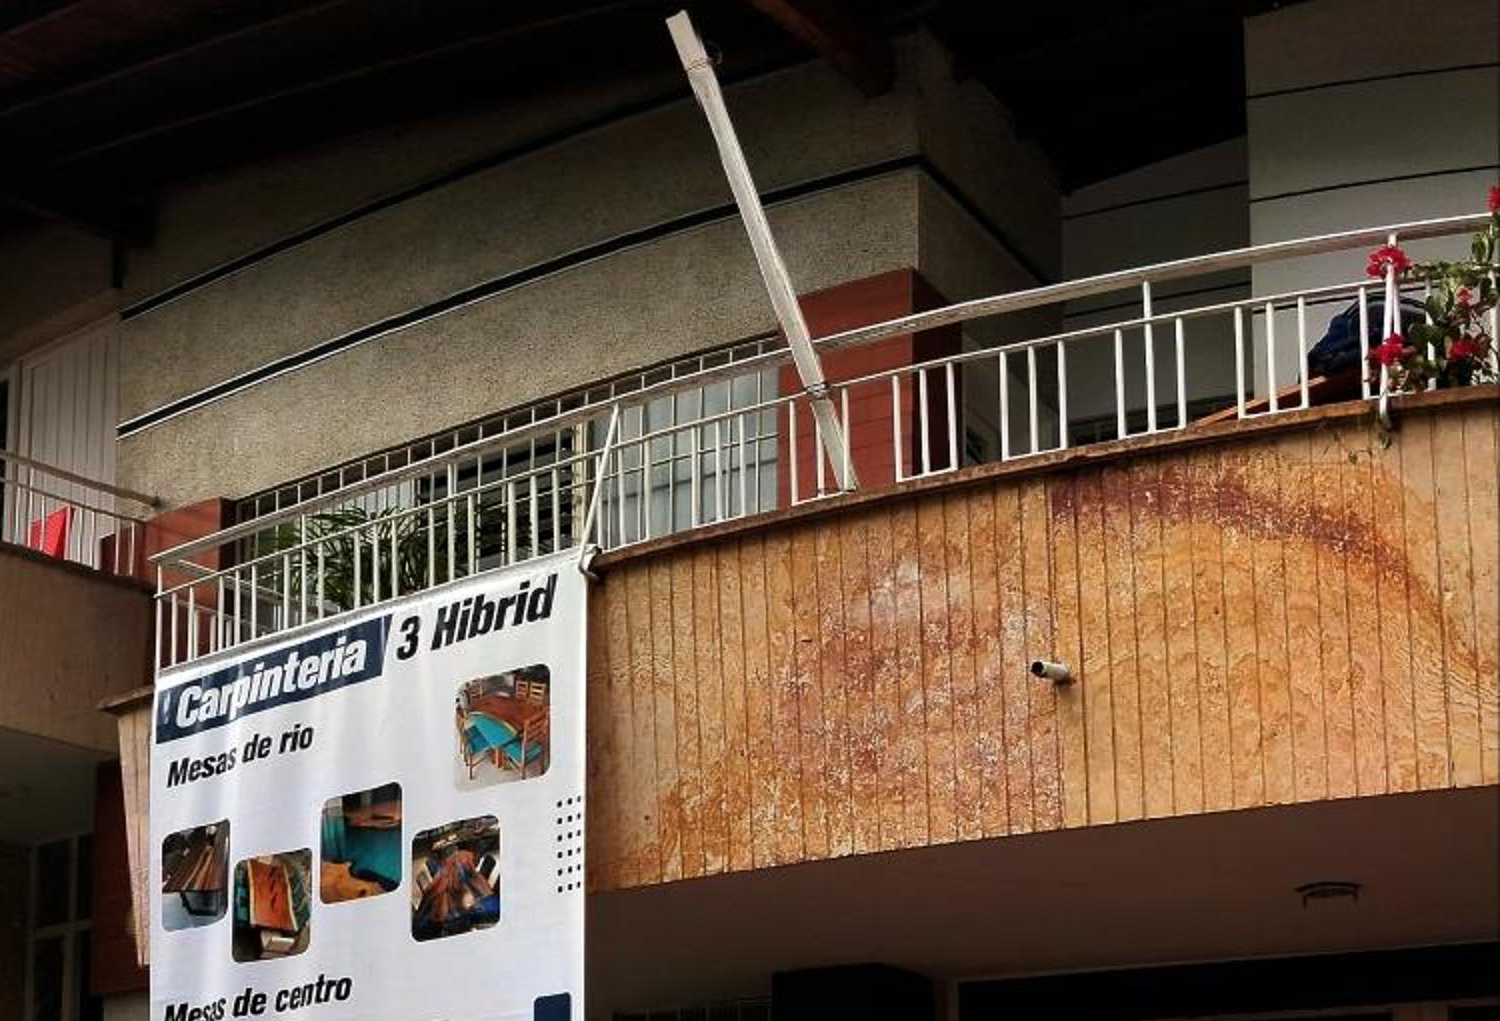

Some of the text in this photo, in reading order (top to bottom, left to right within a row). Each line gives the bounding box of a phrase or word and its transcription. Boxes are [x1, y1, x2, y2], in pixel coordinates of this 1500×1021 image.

[175, 573, 558, 729] Carpinteria 3 Hibrid
[166, 723, 314, 788] Mesas de rio
[233, 987, 267, 1018] de
[275, 974, 352, 1013] centro
